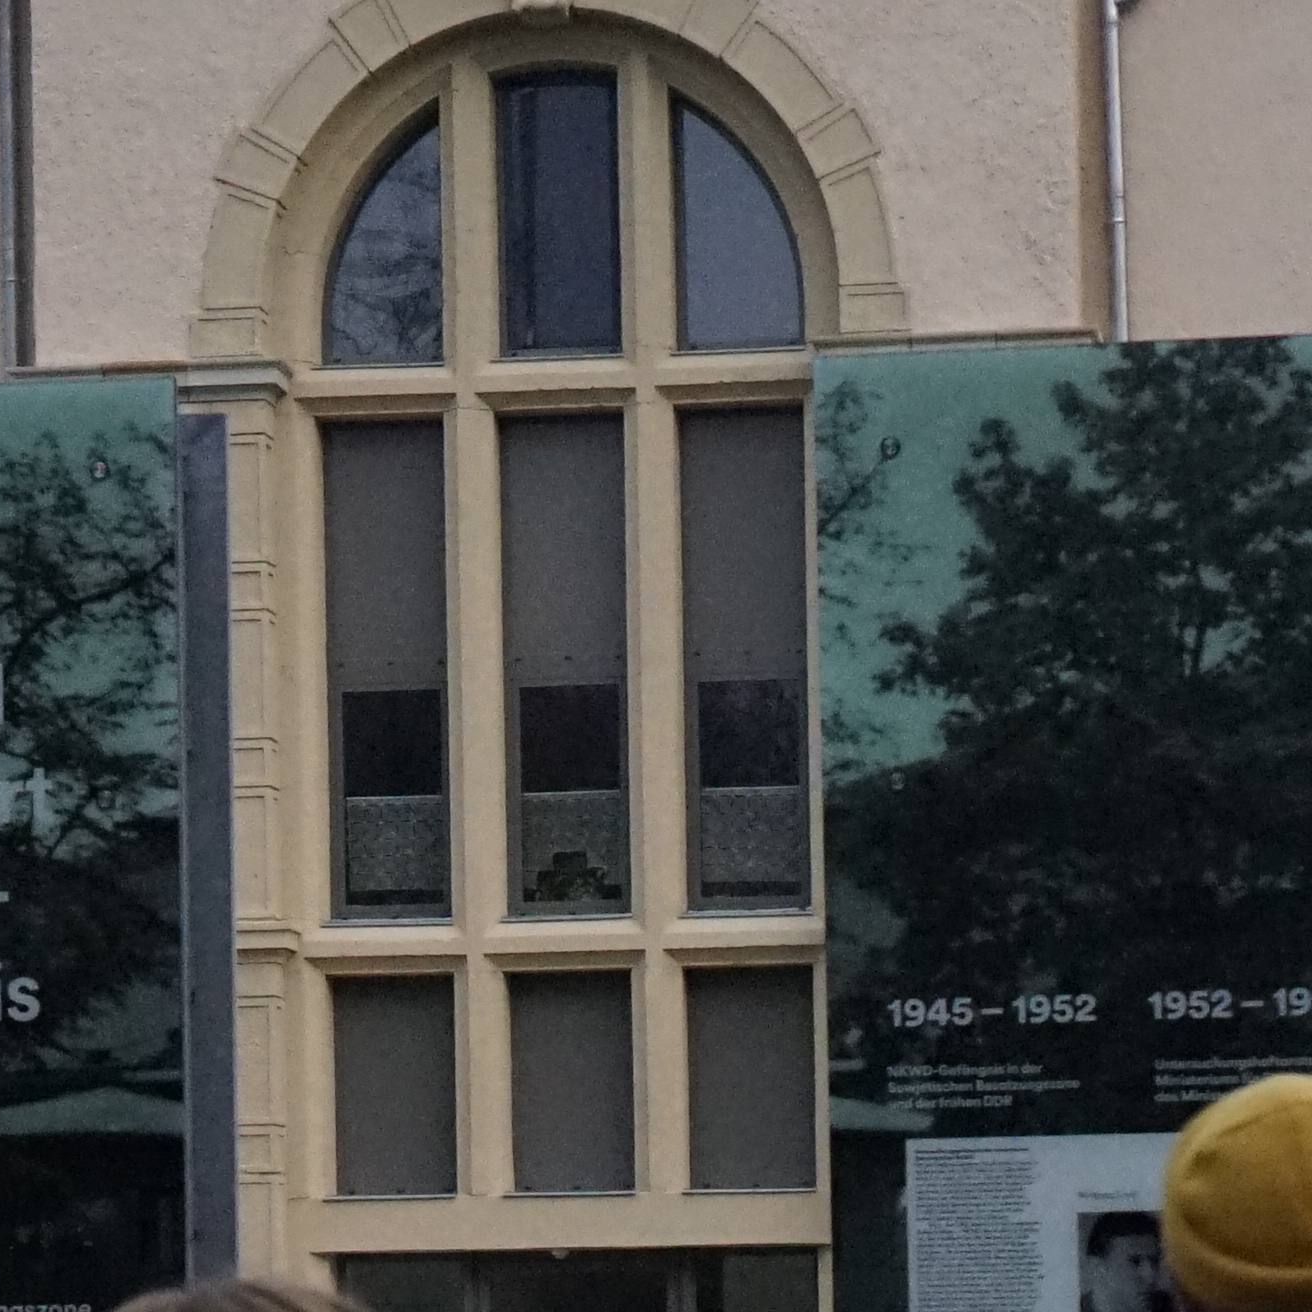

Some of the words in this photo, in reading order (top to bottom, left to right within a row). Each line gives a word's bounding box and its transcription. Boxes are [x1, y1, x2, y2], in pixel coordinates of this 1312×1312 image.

[887, 996, 973, 1030] 1945
[1011, 993, 1098, 1026] 1952
[1147, 989, 1235, 1021] 1952
